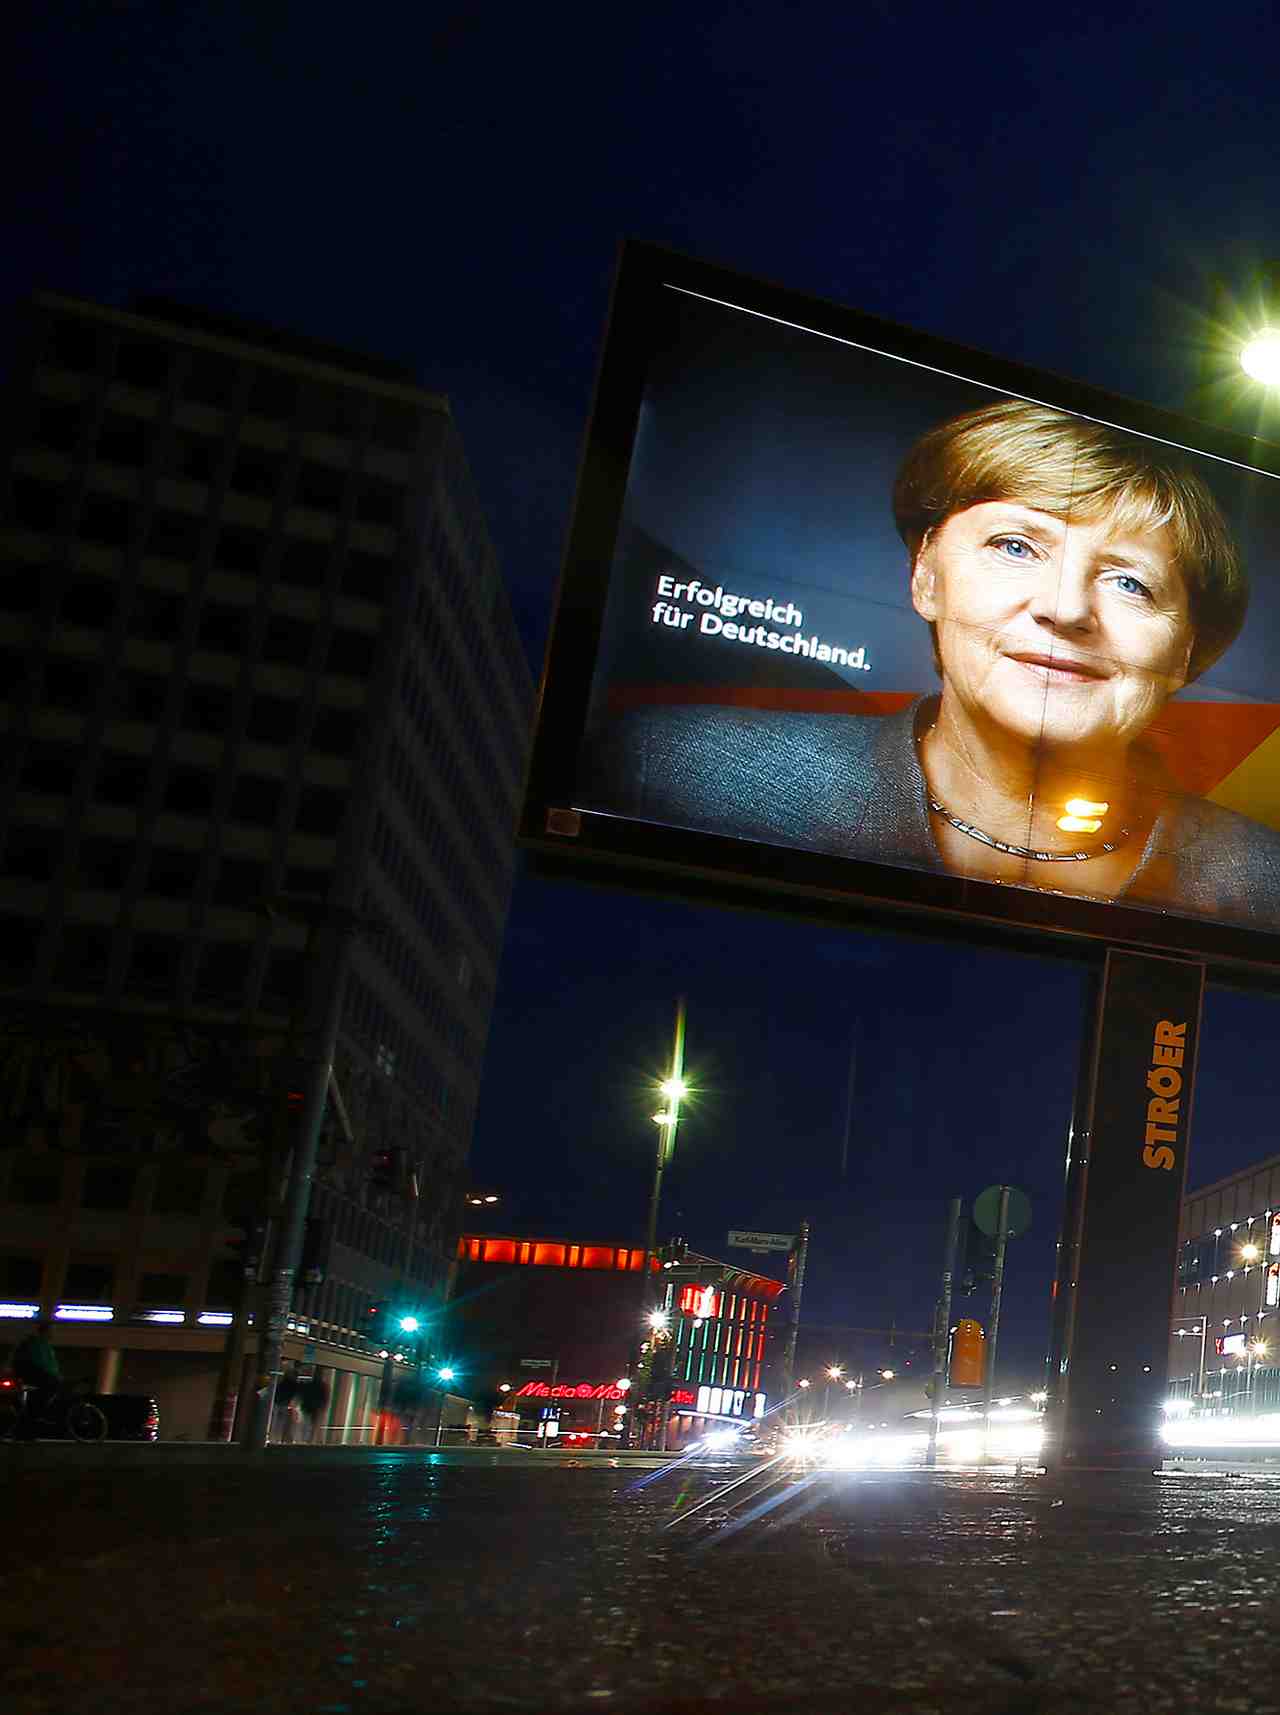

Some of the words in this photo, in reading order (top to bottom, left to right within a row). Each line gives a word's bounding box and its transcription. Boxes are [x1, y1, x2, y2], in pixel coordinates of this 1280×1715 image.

[656, 574, 803, 627] Erfolgreich
[651, 601, 694, 629] für
[699, 612, 872, 671] Deutschland.
[1142, 1019, 1188, 1171] STRÖER
